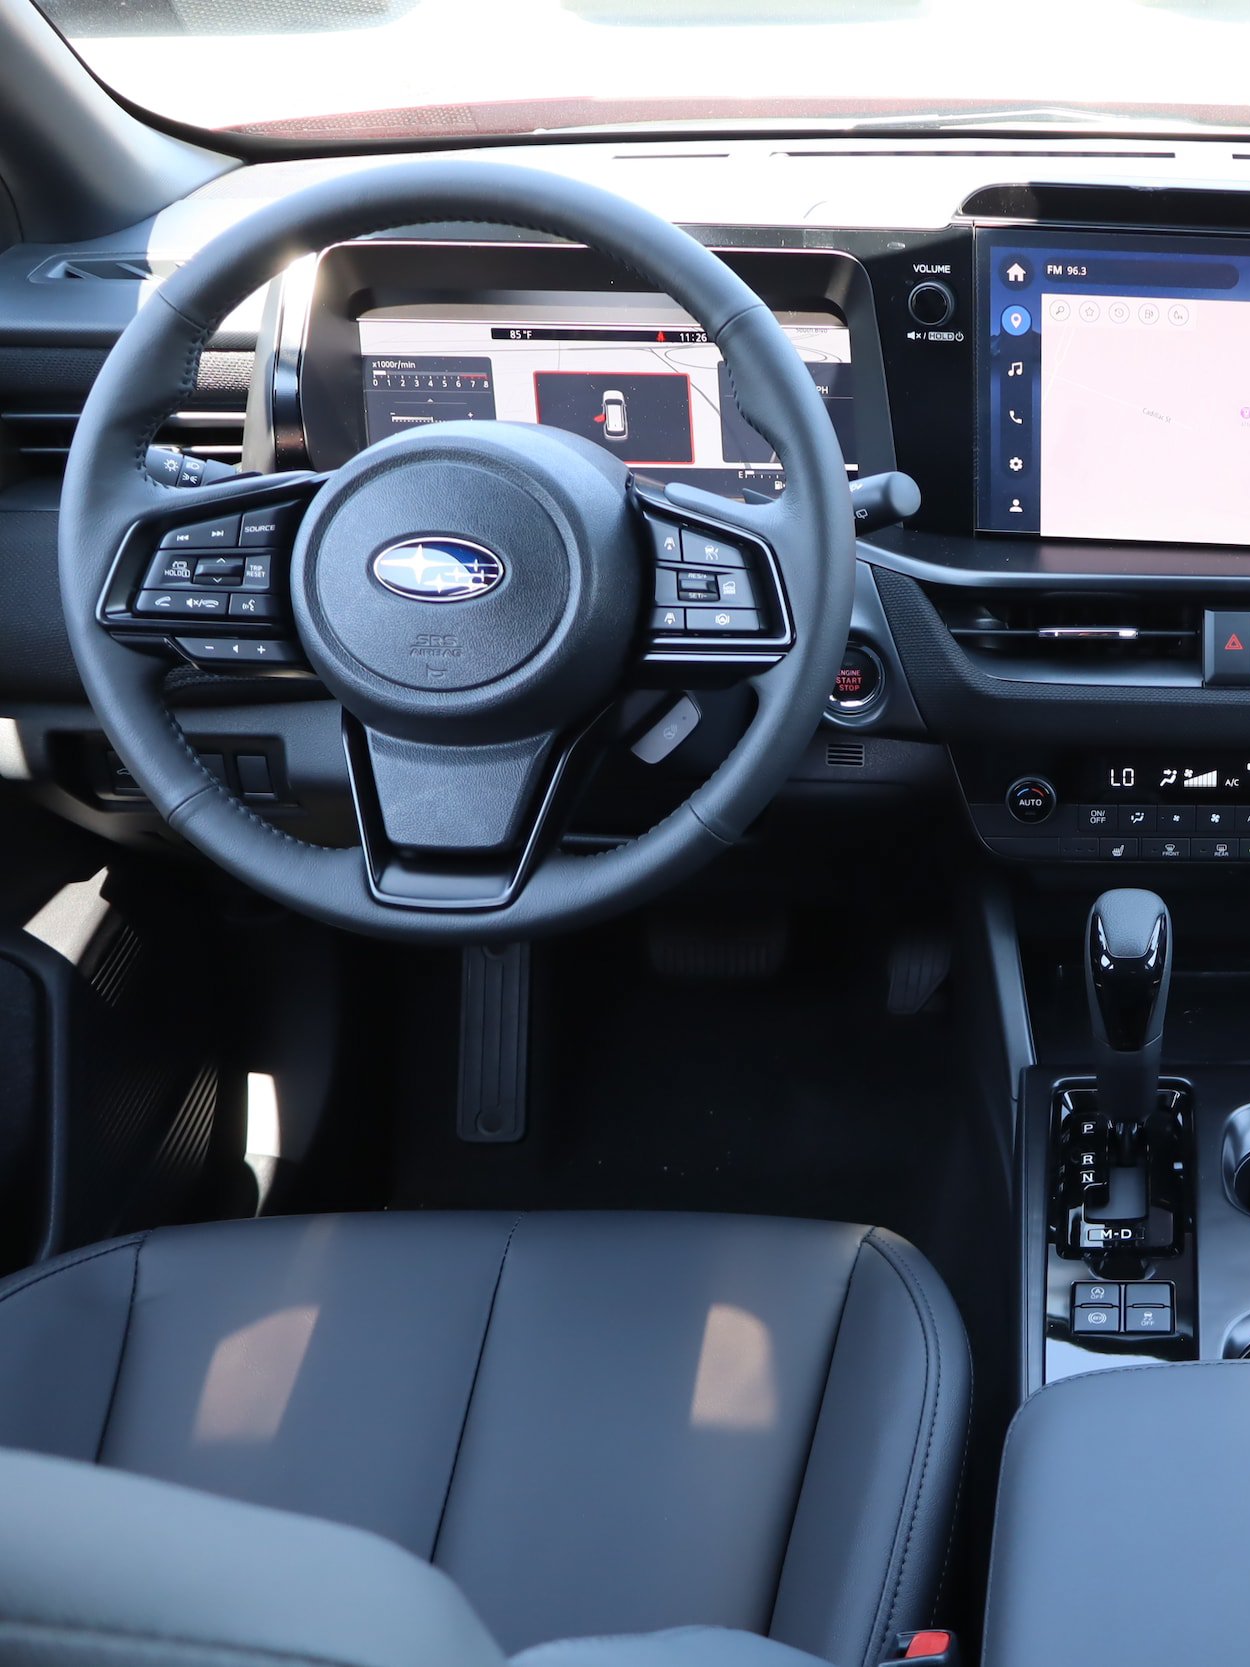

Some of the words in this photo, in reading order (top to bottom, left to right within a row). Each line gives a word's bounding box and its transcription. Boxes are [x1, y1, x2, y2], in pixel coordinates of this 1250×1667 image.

[913, 263, 950, 274] VOLUME
[1047, 265, 1062, 275] FM
[1067, 267, 1087, 276] 96.3
[679, 332, 708, 342] 11:26
[929, 332, 954, 341] HOLD
[372, 361, 416, 370] x1000r/min
[456, 380, 461, 388] 6
[470, 380, 476, 388] 7
[816, 386, 829, 394] PH
[738, 471, 743, 479] E
[244, 524, 276, 533] SOURCE
[415, 633, 459, 646] SRS
[410, 647, 463, 658] AIRBAG
[838, 669, 861, 677] NGINE
[839, 684, 860, 692] STOP
[1110, 768, 1135, 787] LO
[1224, 778, 1240, 788] A/C
[1019, 799, 1043, 807] AUTO
[1083, 1124, 1094, 1133] P
[1082, 1155, 1094, 1165] R
[1082, 1173, 1093, 1183] N
